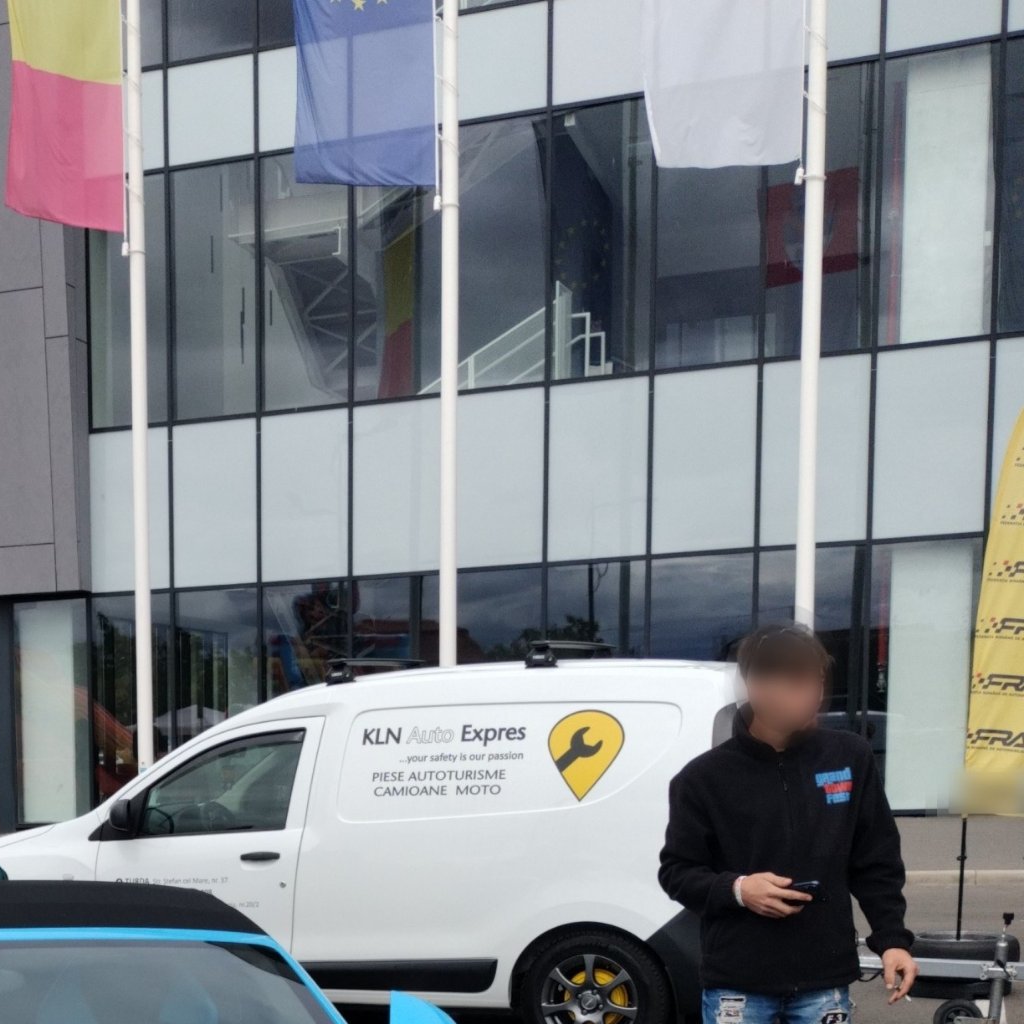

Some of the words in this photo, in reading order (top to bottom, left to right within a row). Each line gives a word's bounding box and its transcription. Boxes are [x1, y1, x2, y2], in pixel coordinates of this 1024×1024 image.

[362, 727, 402, 746] KLN
[406, 726, 455, 745] Auto
[461, 724, 527, 747] Expres
[429, 753, 457, 763] safety
[459, 752, 467, 761] is
[469, 753, 485, 761] our
[487, 750, 524, 762] passion
[372, 771, 405, 782] PIESE
[408, 769, 506, 782] AUTOTURISME
[373, 785, 447, 797] CAMIOANE
[455, 784, 502, 796] MOTO
